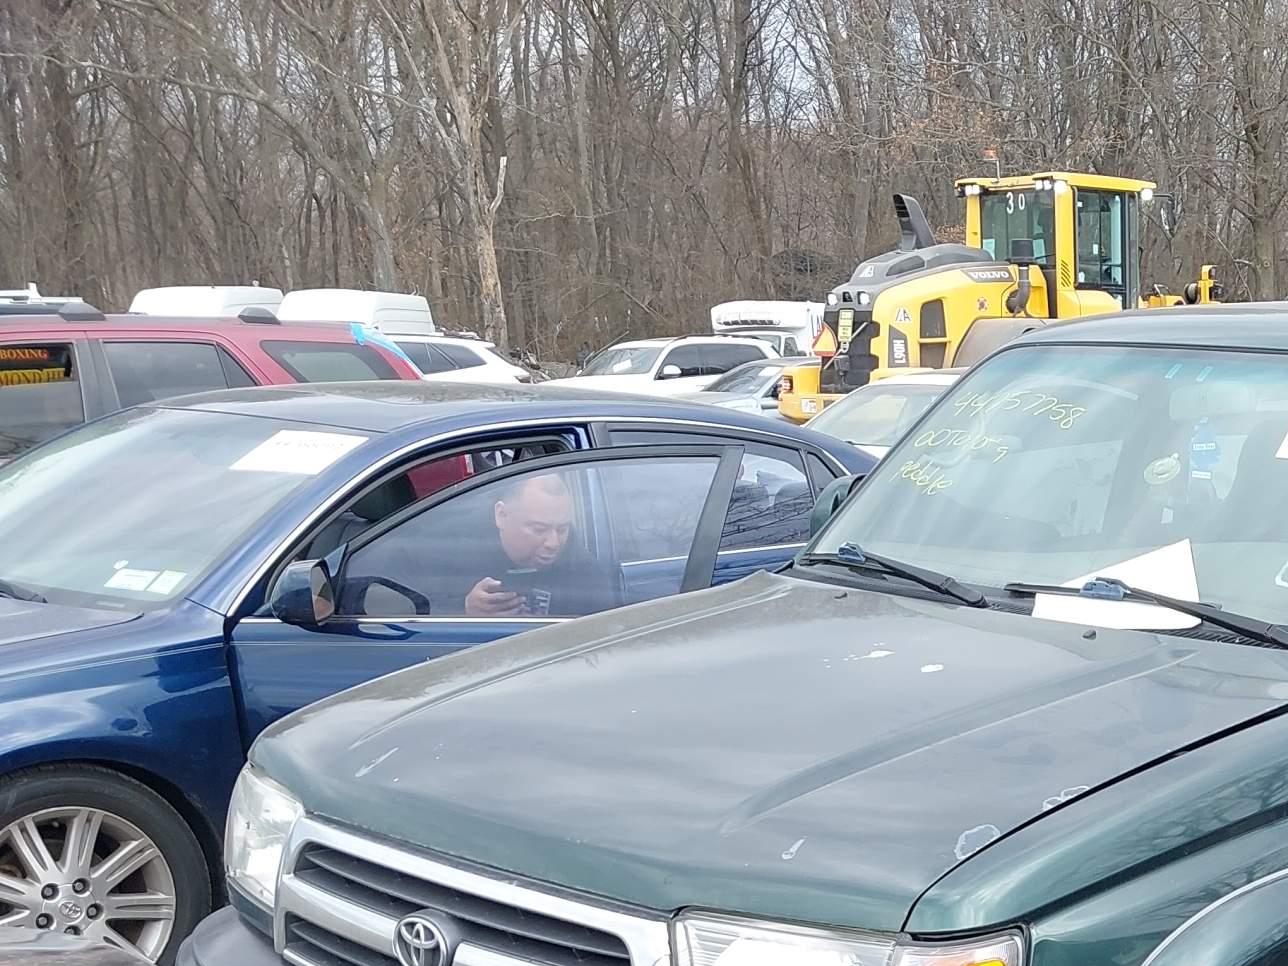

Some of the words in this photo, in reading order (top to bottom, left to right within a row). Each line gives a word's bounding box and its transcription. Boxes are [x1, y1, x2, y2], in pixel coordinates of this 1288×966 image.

[968, 270, 1011, 279] VOLVO
[0, 348, 49, 360] BOXING
[893, 339, 907, 364] L90H
